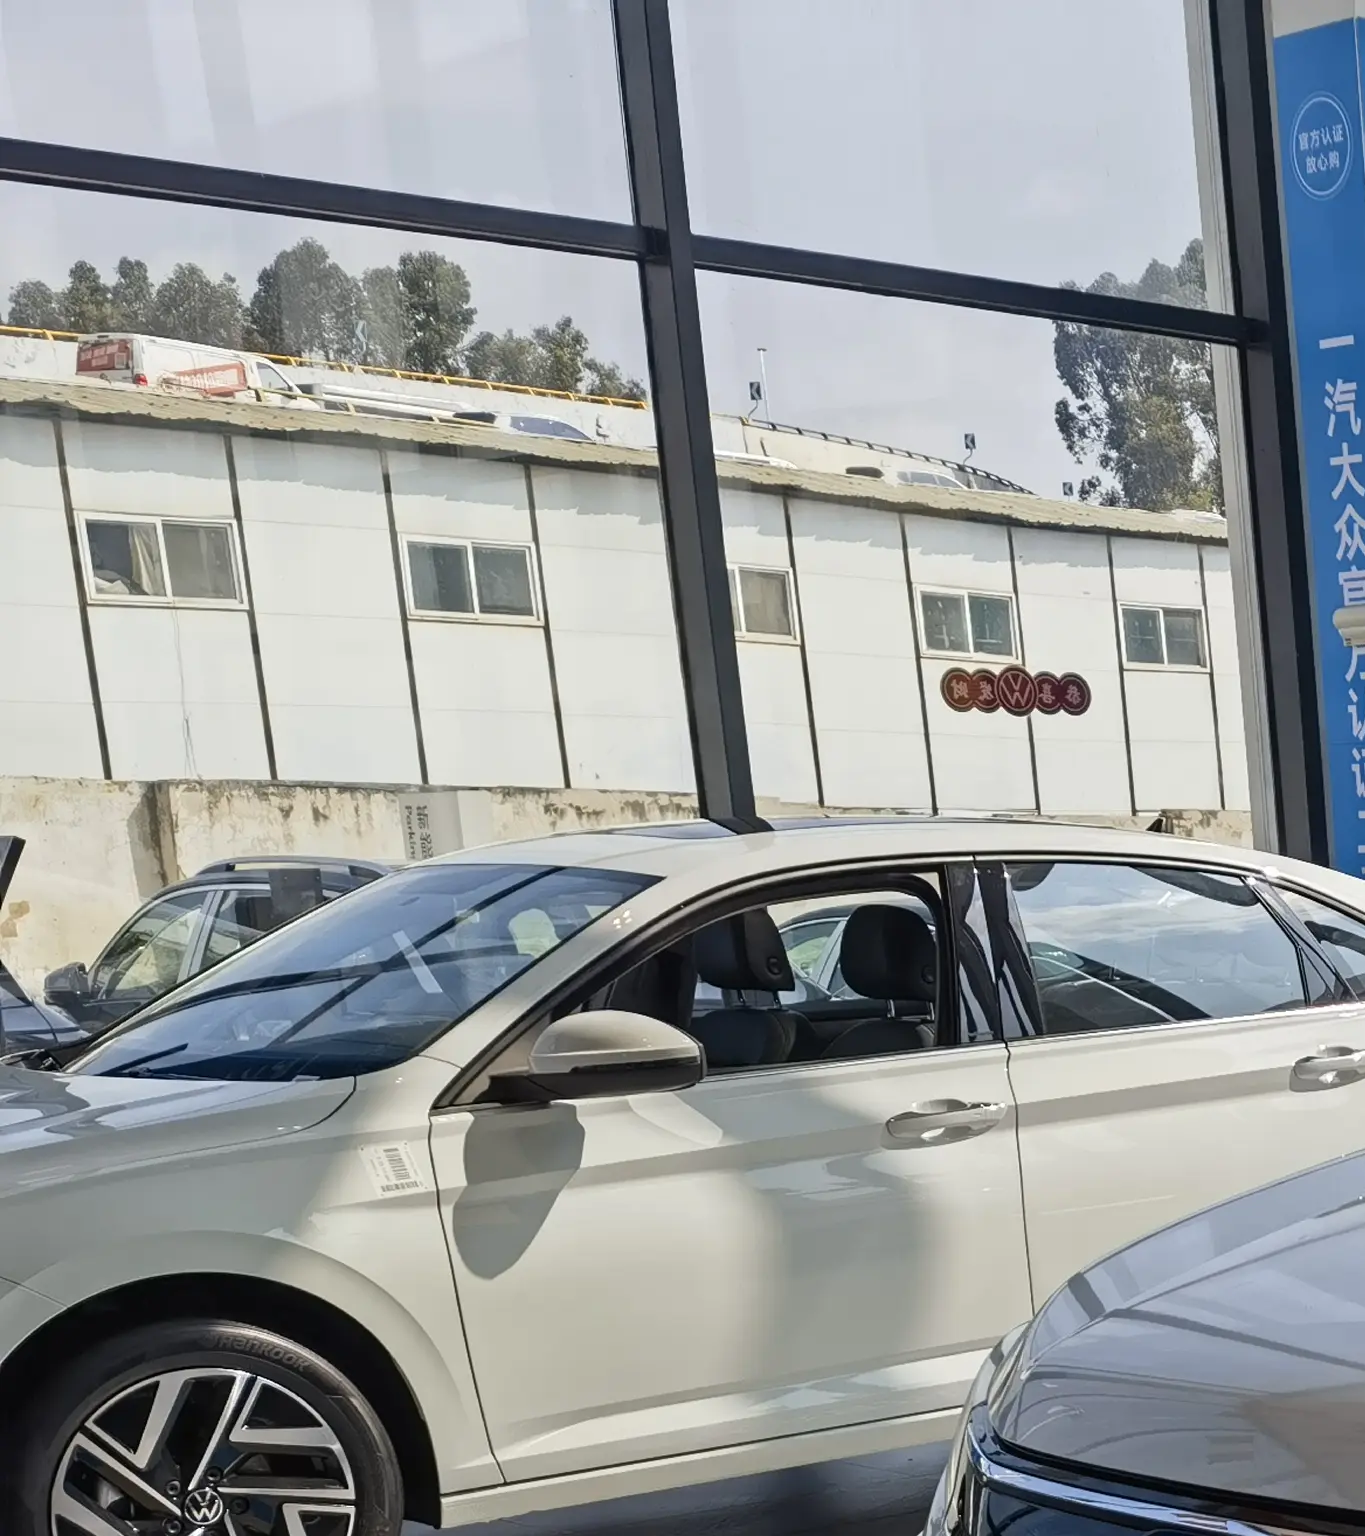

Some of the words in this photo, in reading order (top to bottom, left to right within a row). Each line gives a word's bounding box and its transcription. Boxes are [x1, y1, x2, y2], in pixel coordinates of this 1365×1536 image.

[1299, 124, 1344, 151] 官方认证
[1306, 150, 1340, 174] 放心购
